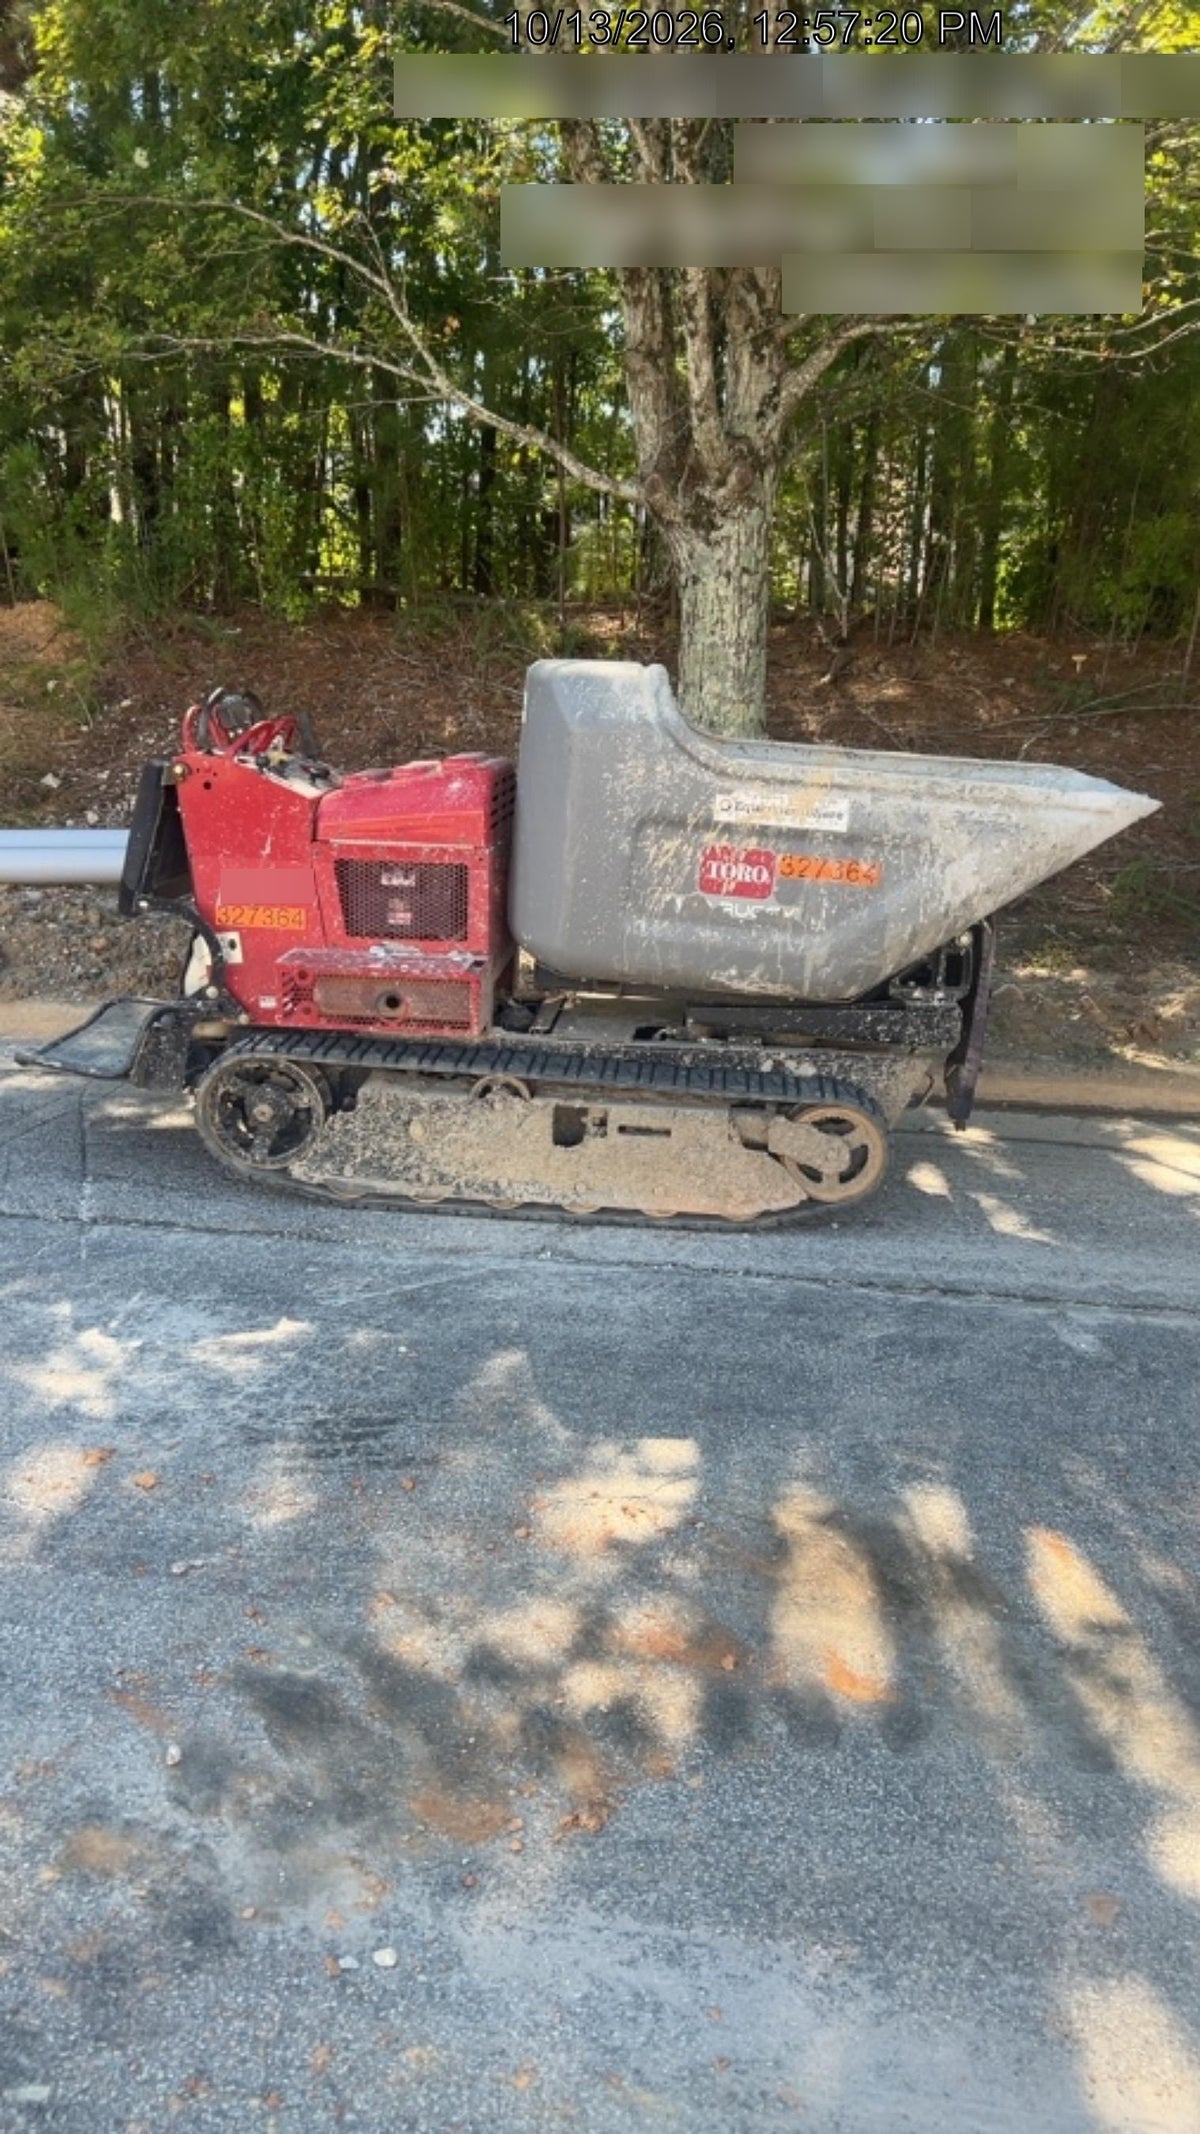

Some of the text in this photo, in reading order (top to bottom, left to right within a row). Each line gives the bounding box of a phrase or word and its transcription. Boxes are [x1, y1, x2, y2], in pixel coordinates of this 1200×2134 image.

[706, 860, 769, 883] TORO
[780, 855, 876, 884] 327364
[217, 905, 304, 928] 327364
